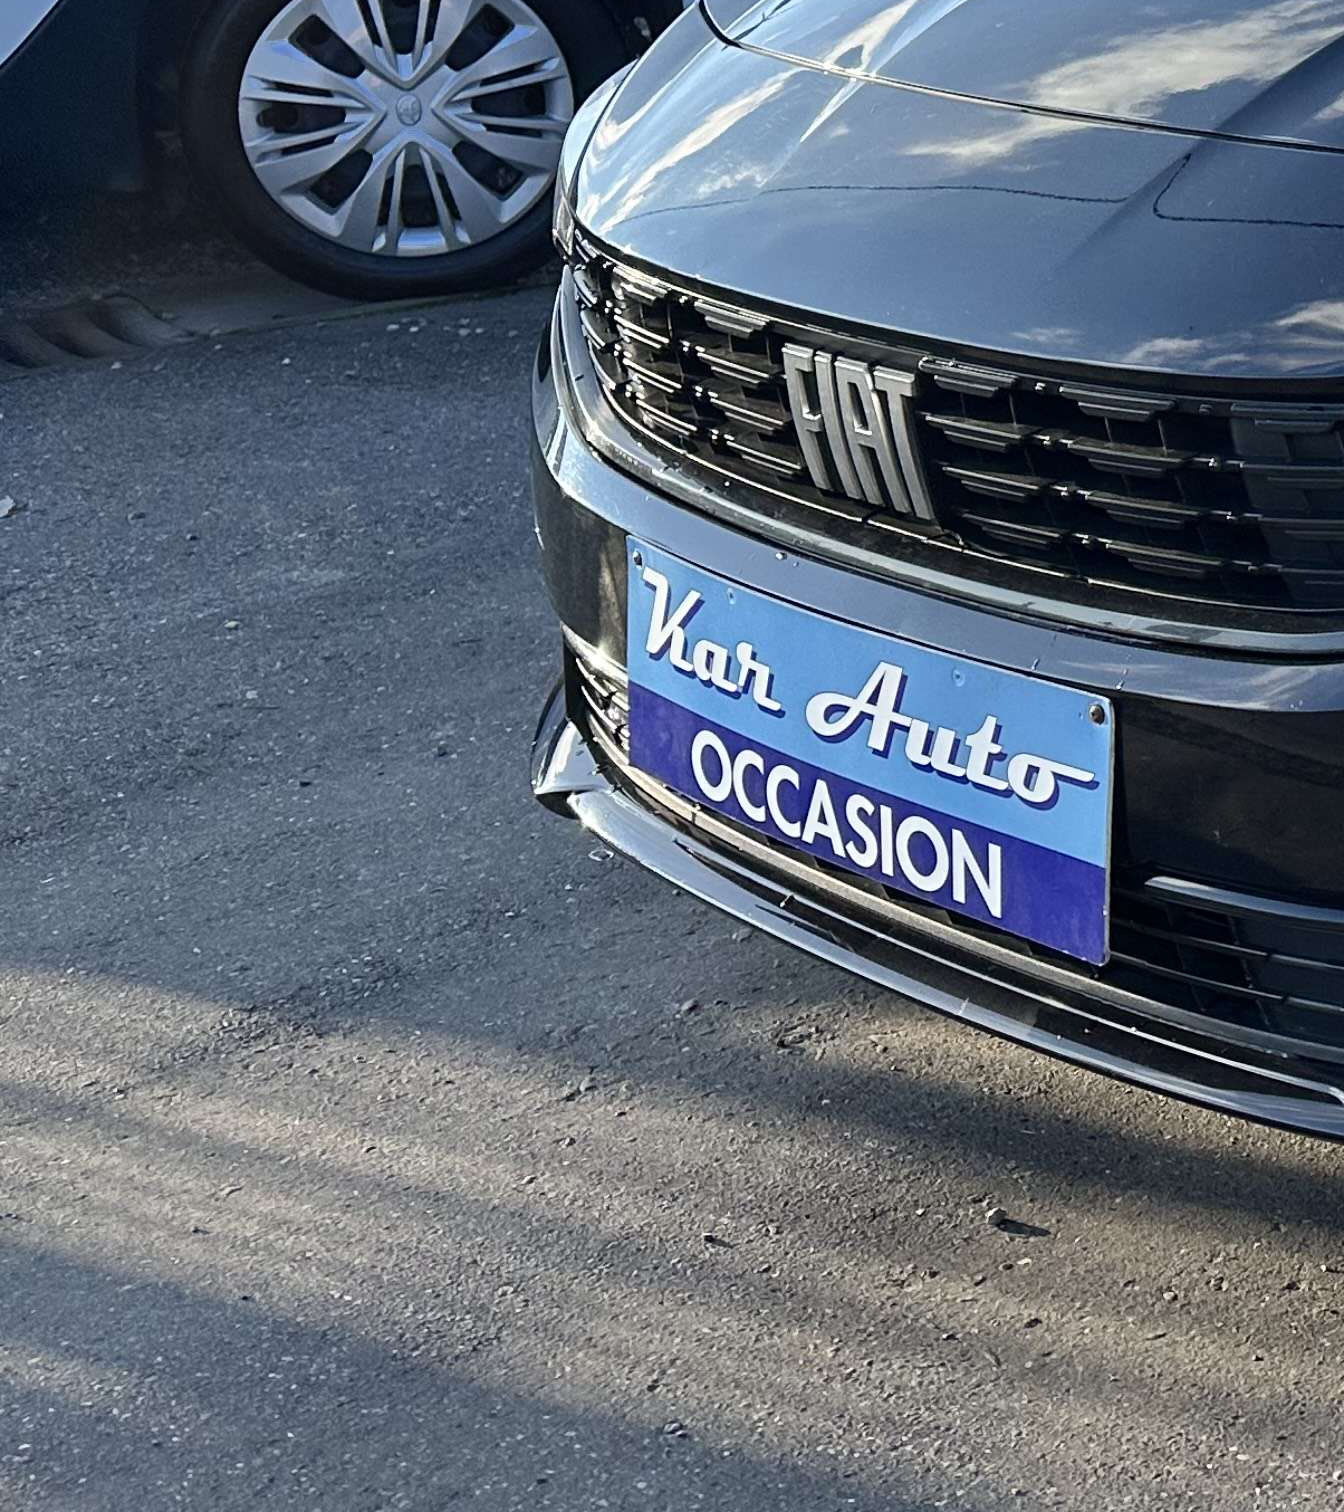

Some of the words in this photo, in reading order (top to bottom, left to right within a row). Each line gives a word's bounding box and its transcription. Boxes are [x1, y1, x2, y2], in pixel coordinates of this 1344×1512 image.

[781, 342, 938, 522] FIAT
[641, 567, 782, 714] Kar
[804, 662, 1094, 805] Auto
[690, 730, 1002, 919] OCCASION
